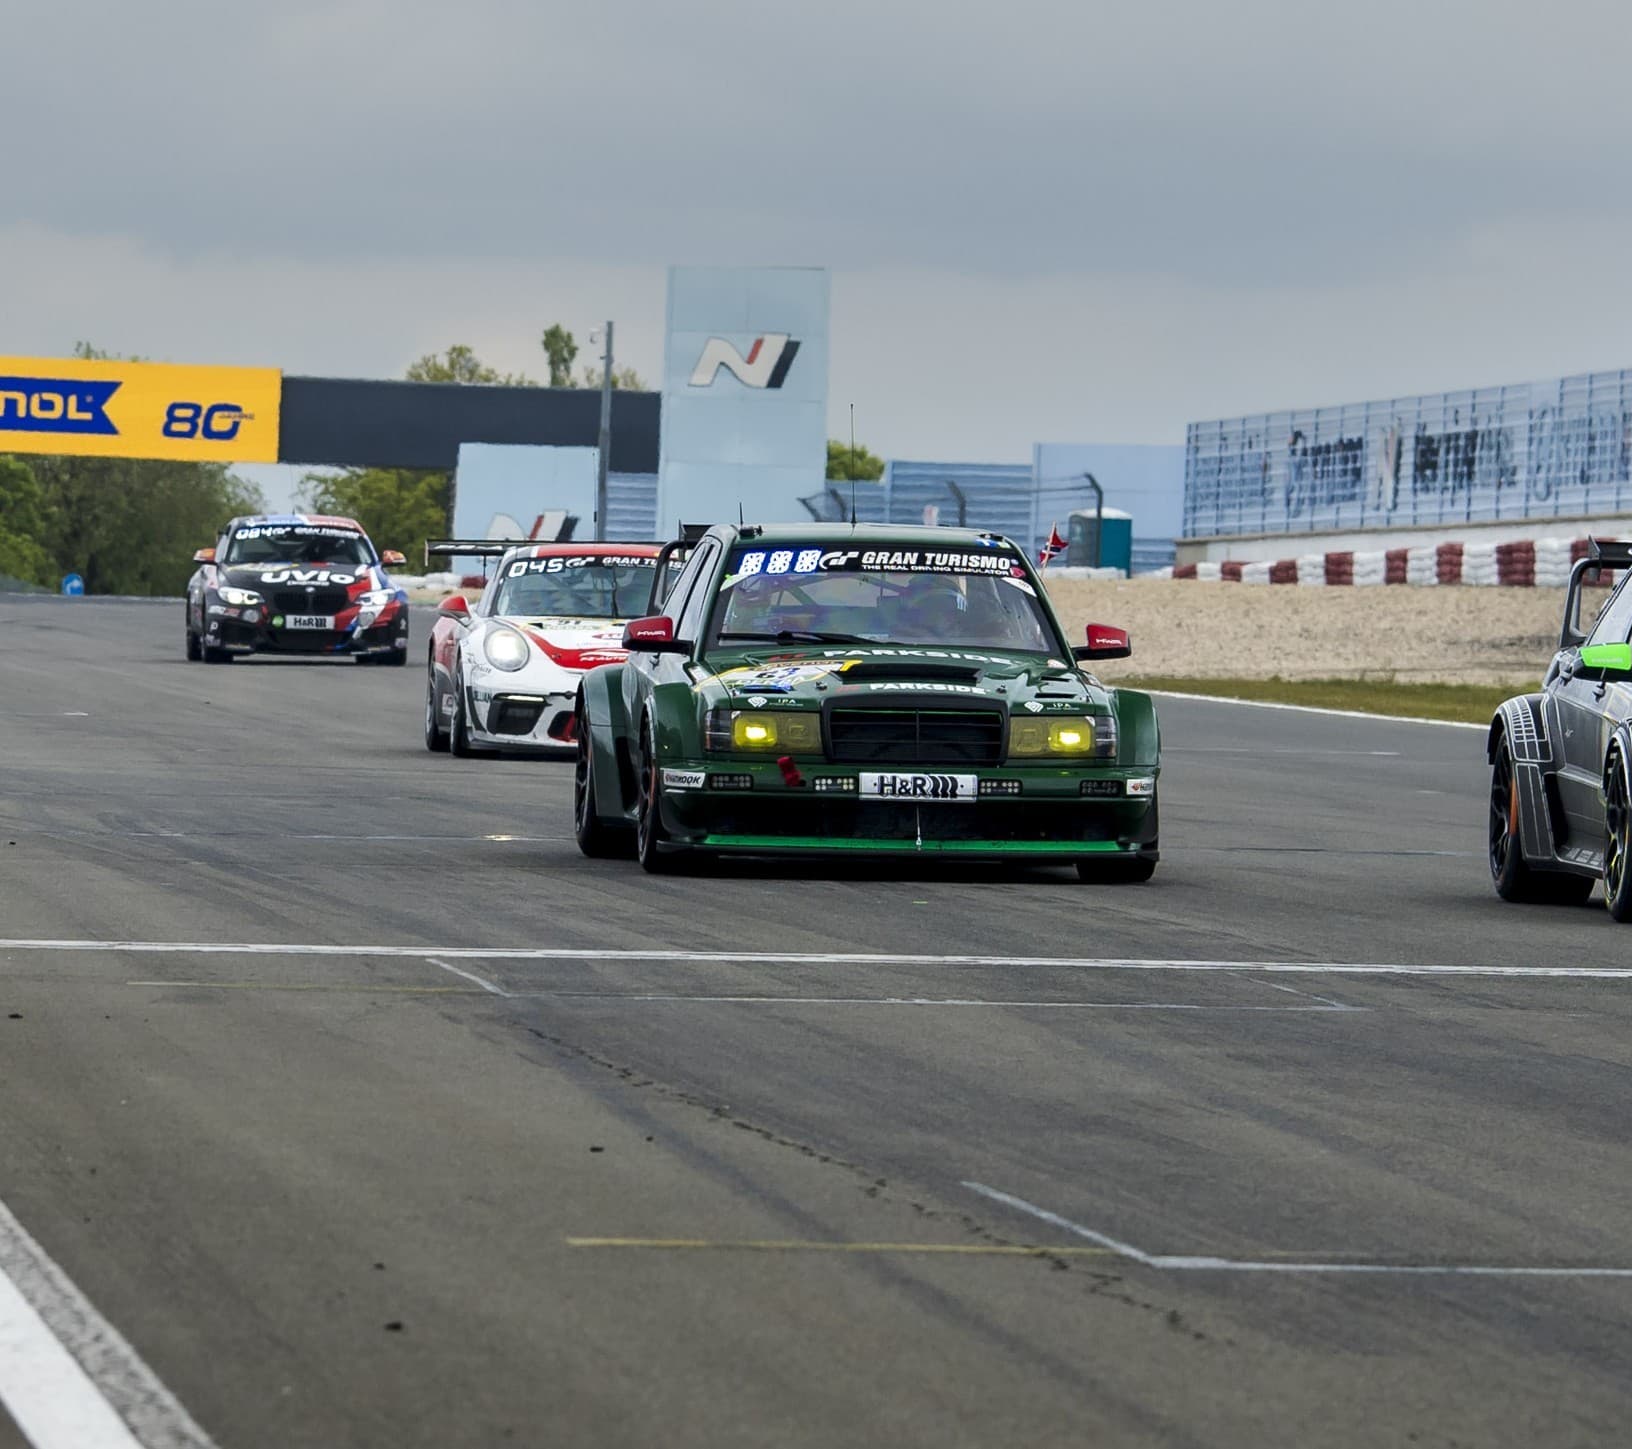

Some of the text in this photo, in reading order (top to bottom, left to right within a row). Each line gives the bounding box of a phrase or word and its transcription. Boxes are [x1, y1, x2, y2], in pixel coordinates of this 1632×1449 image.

[162, 402, 242, 440] 80
[508, 557, 564, 578] 045
[602, 557, 640, 566] GRAN
[862, 551, 1010, 570] GRAN TURISMO
[911, 565, 951, 573] DRIVING
[953, 567, 1009, 577] SIMULATOR
[823, 649, 1015, 665] PARKSIDE
[870, 683, 986, 695] PARKSIDE
[878, 775, 927, 796] H&R
